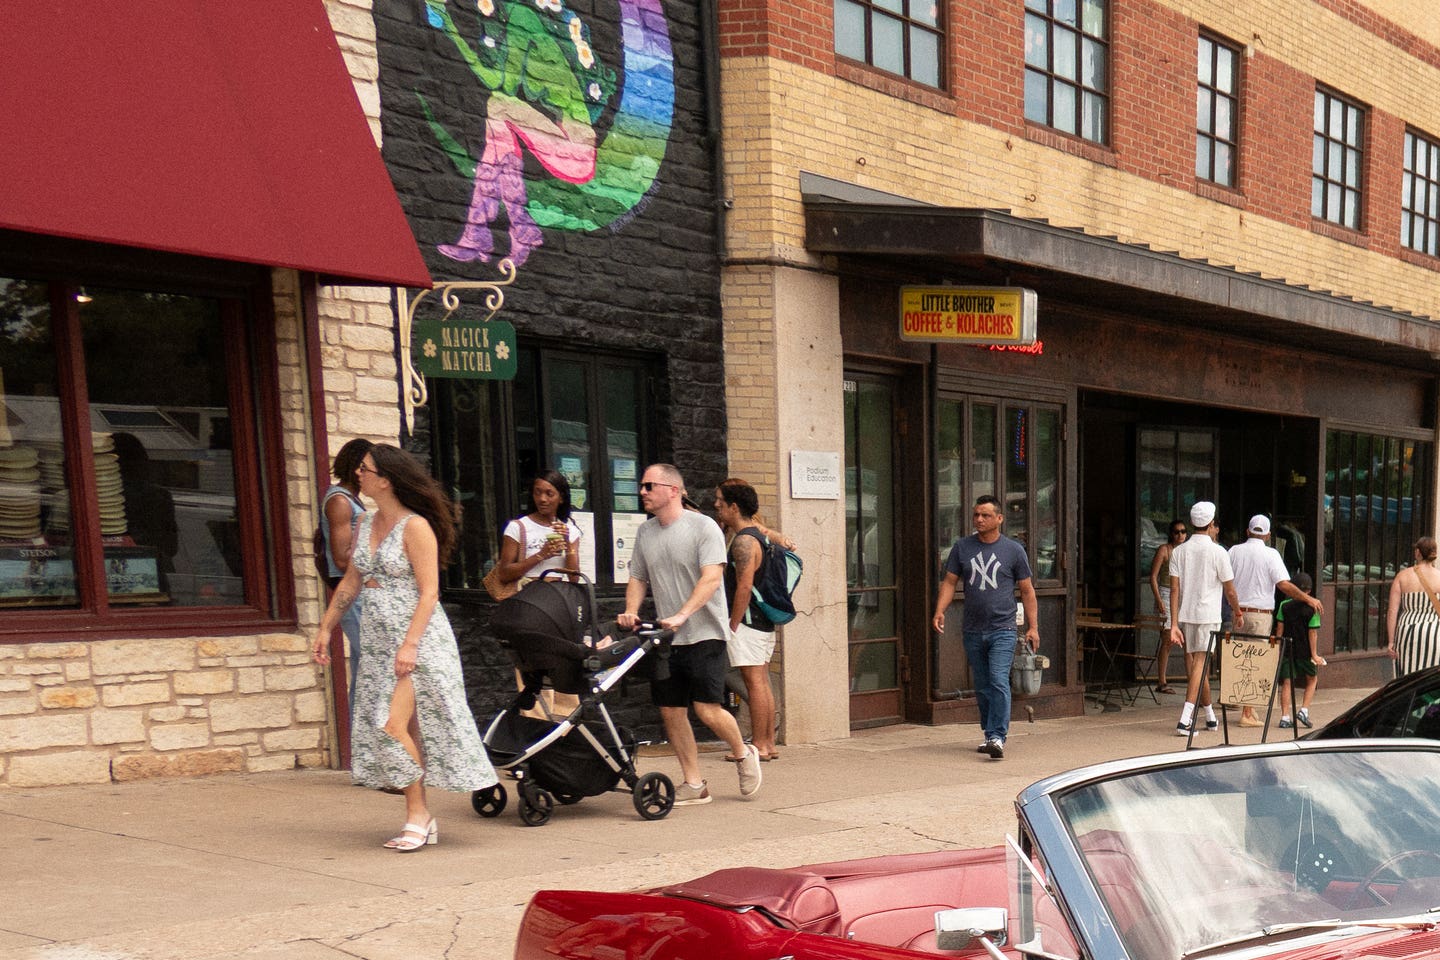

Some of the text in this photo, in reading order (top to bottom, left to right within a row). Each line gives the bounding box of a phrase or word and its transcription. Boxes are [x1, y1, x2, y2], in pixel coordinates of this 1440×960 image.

[921, 293, 995, 313] LITTLE BROTHER
[904, 311, 1014, 336] COFFEE & KOLACHES
[442, 327, 489, 348] MAGICK
[442, 351, 492, 372] MATCHA
[969, 551, 1002, 591] NY
[1232, 640, 1270, 659] Coffee
